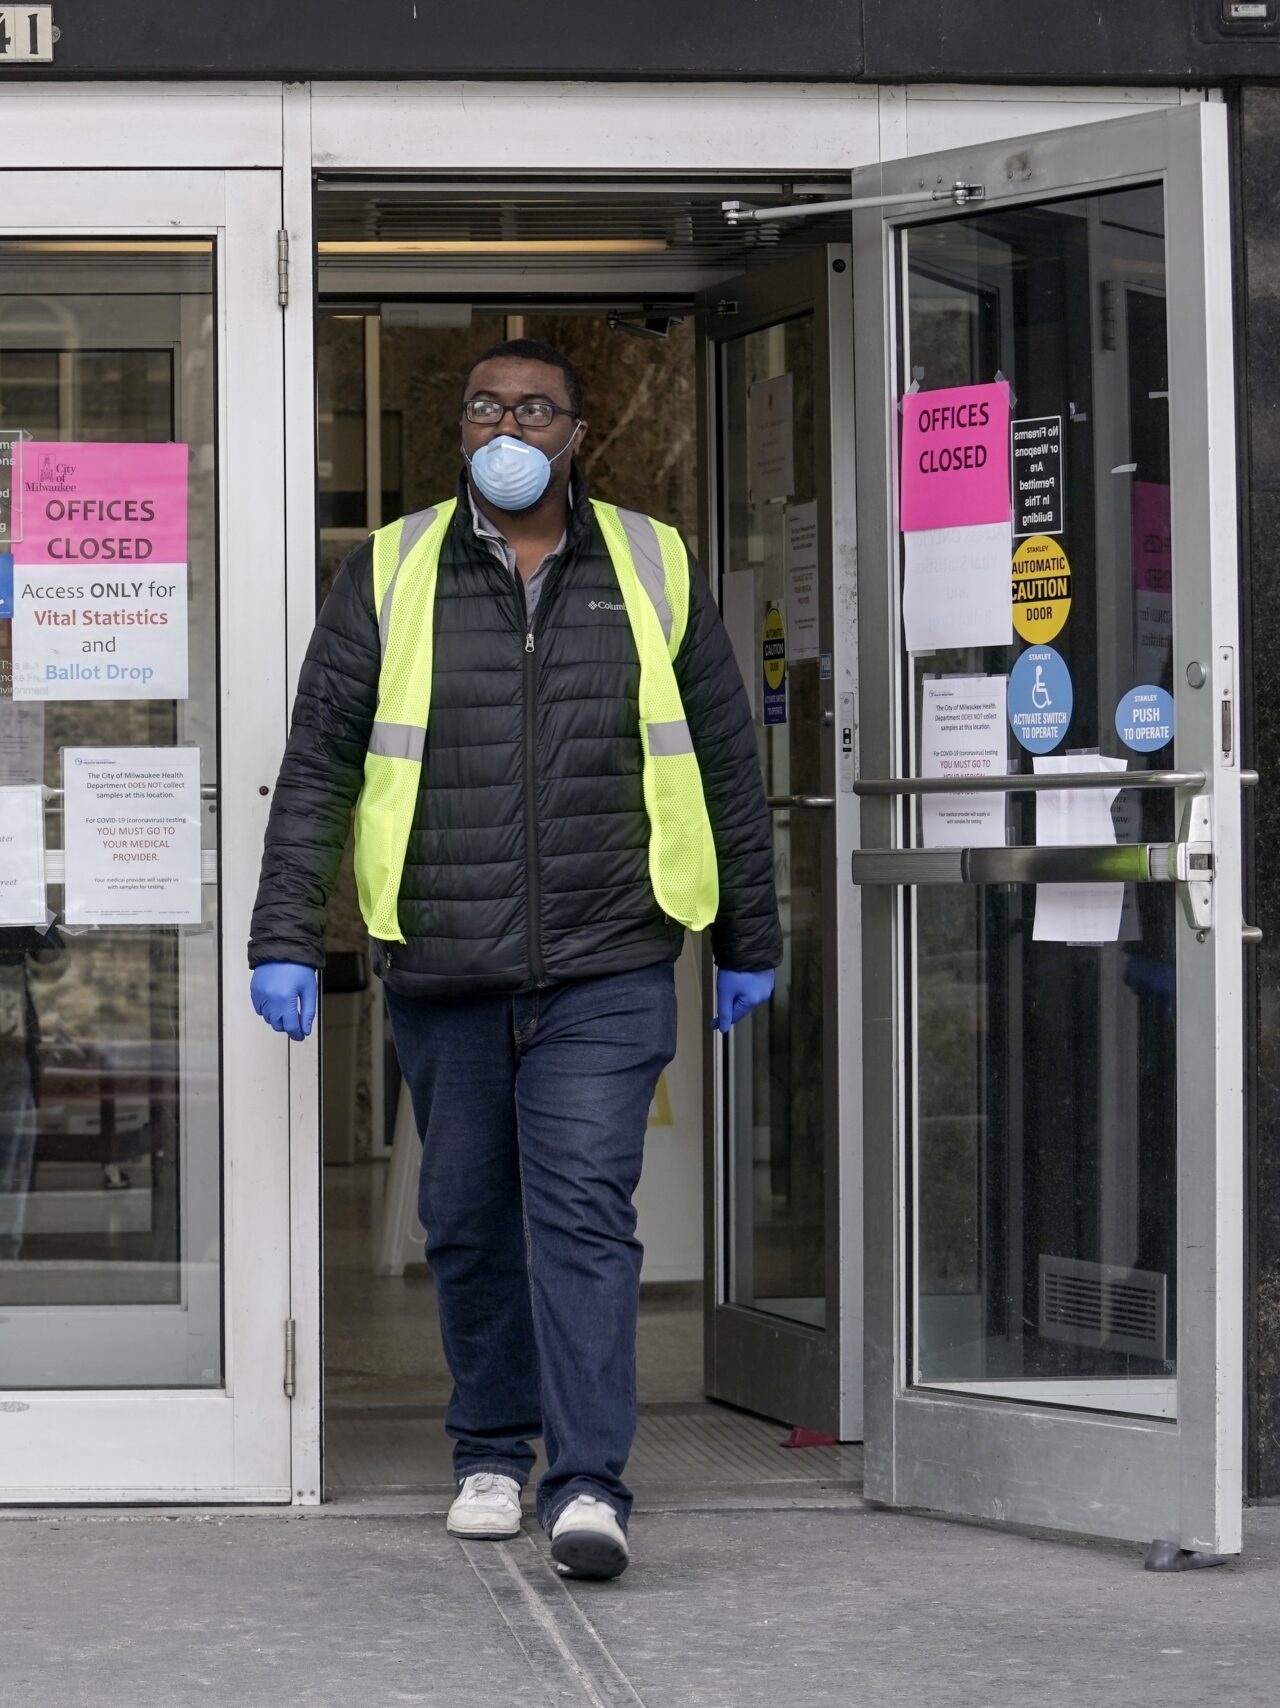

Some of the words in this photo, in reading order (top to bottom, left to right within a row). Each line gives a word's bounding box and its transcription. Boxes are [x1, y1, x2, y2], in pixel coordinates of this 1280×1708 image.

[918, 402, 989, 432] OFFICES
[920, 445, 987, 474] CLOSED
[56, 464, 76, 475] City
[56, 474, 66, 482] of
[25, 482, 76, 492] Milwaukee
[46, 500, 155, 521] OFFICES
[48, 538, 152, 559] CLOSED
[1012, 557, 1065, 574] AUTOMATIC
[21, 584, 84, 599] Access
[91, 583, 142, 598] ONLY
[148, 581, 176, 597] for
[1012, 578, 1067, 600] CAUTION
[34, 609, 76, 626] Vital
[83, 609, 168, 625] Statistics
[1027, 607, 1052, 621] DOOR
[82, 636, 116, 653] and
[46, 664, 101, 680] Ballot
[107, 664, 153, 683] Drop
[1014, 713, 1041, 724] ACTIVATE
[1043, 712, 1066, 724] SWITCH
[1132, 708, 1160, 723] PUSH
[1022, 727, 1030, 738] TO
[1032, 727, 1058, 738] OPERATE
[1124, 728, 1134, 740] TO
[1136, 726, 1169, 740] OPERATE
[102, 772, 114, 780] City
[86, 782, 126, 790] Department
[97, 827, 116, 835] YOU
[120, 827, 144, 835] MUST
[146, 827, 160, 835] GO
[163, 827, 175, 835] TO
[103, 840, 128, 848] YOUR
[131, 840, 170, 848] MEDICAL
[113, 853, 159, 861] PROVIDER.
